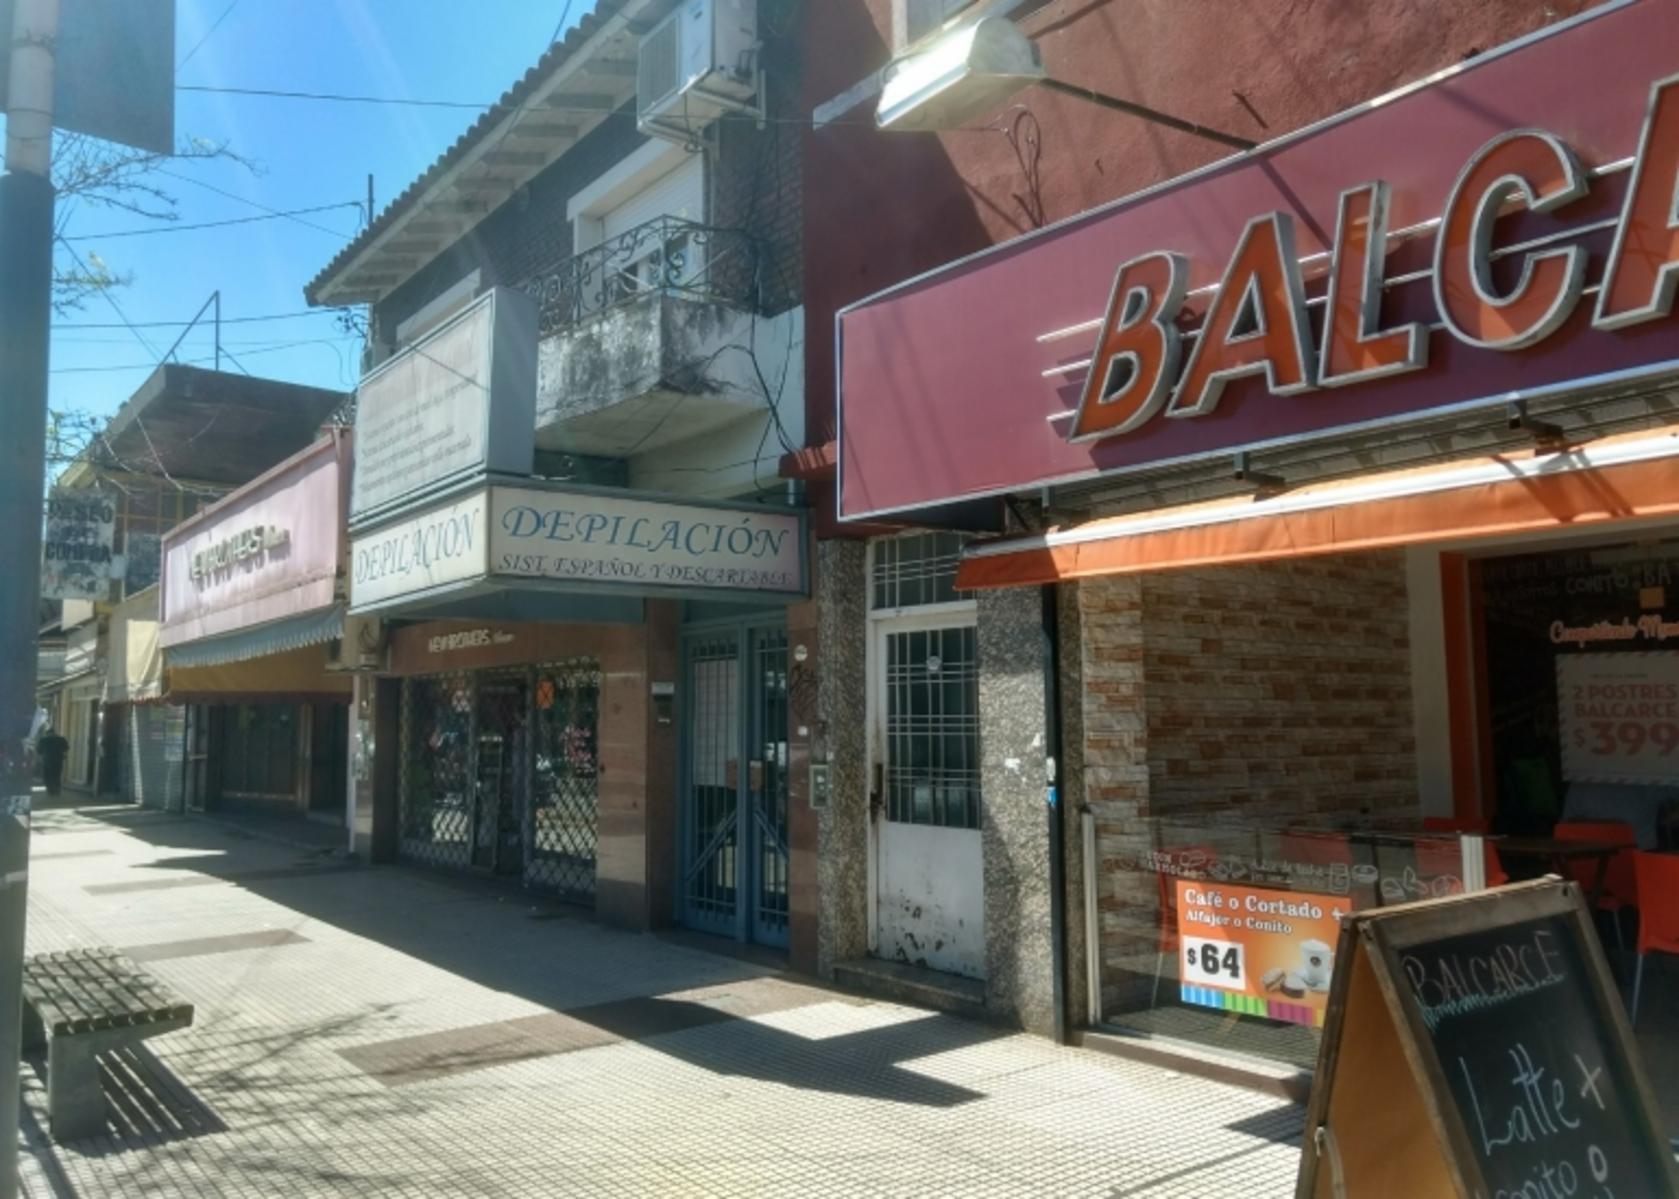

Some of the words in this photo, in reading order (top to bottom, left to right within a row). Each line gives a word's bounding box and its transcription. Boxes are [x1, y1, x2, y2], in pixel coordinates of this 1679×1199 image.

[355, 505, 479, 585] DEPILACIÓN
[502, 505, 790, 558] DEPILACIÓN
[553, 557, 646, 578] ESPAÑOL
[1573, 685, 1584, 699] 2
[1588, 684, 1678, 700] POSTRES
[1575, 702, 1678, 718] BALCARCE
[1184, 888, 1223, 907] Café
[1229, 897, 1240, 910] o
[1245, 895, 1323, 920] Cortado
[1185, 908, 1230, 927] Alfajor
[1233, 917, 1242, 927] o
[1246, 917, 1293, 935] Conito
[1458, 1043, 1581, 1157] Latte
